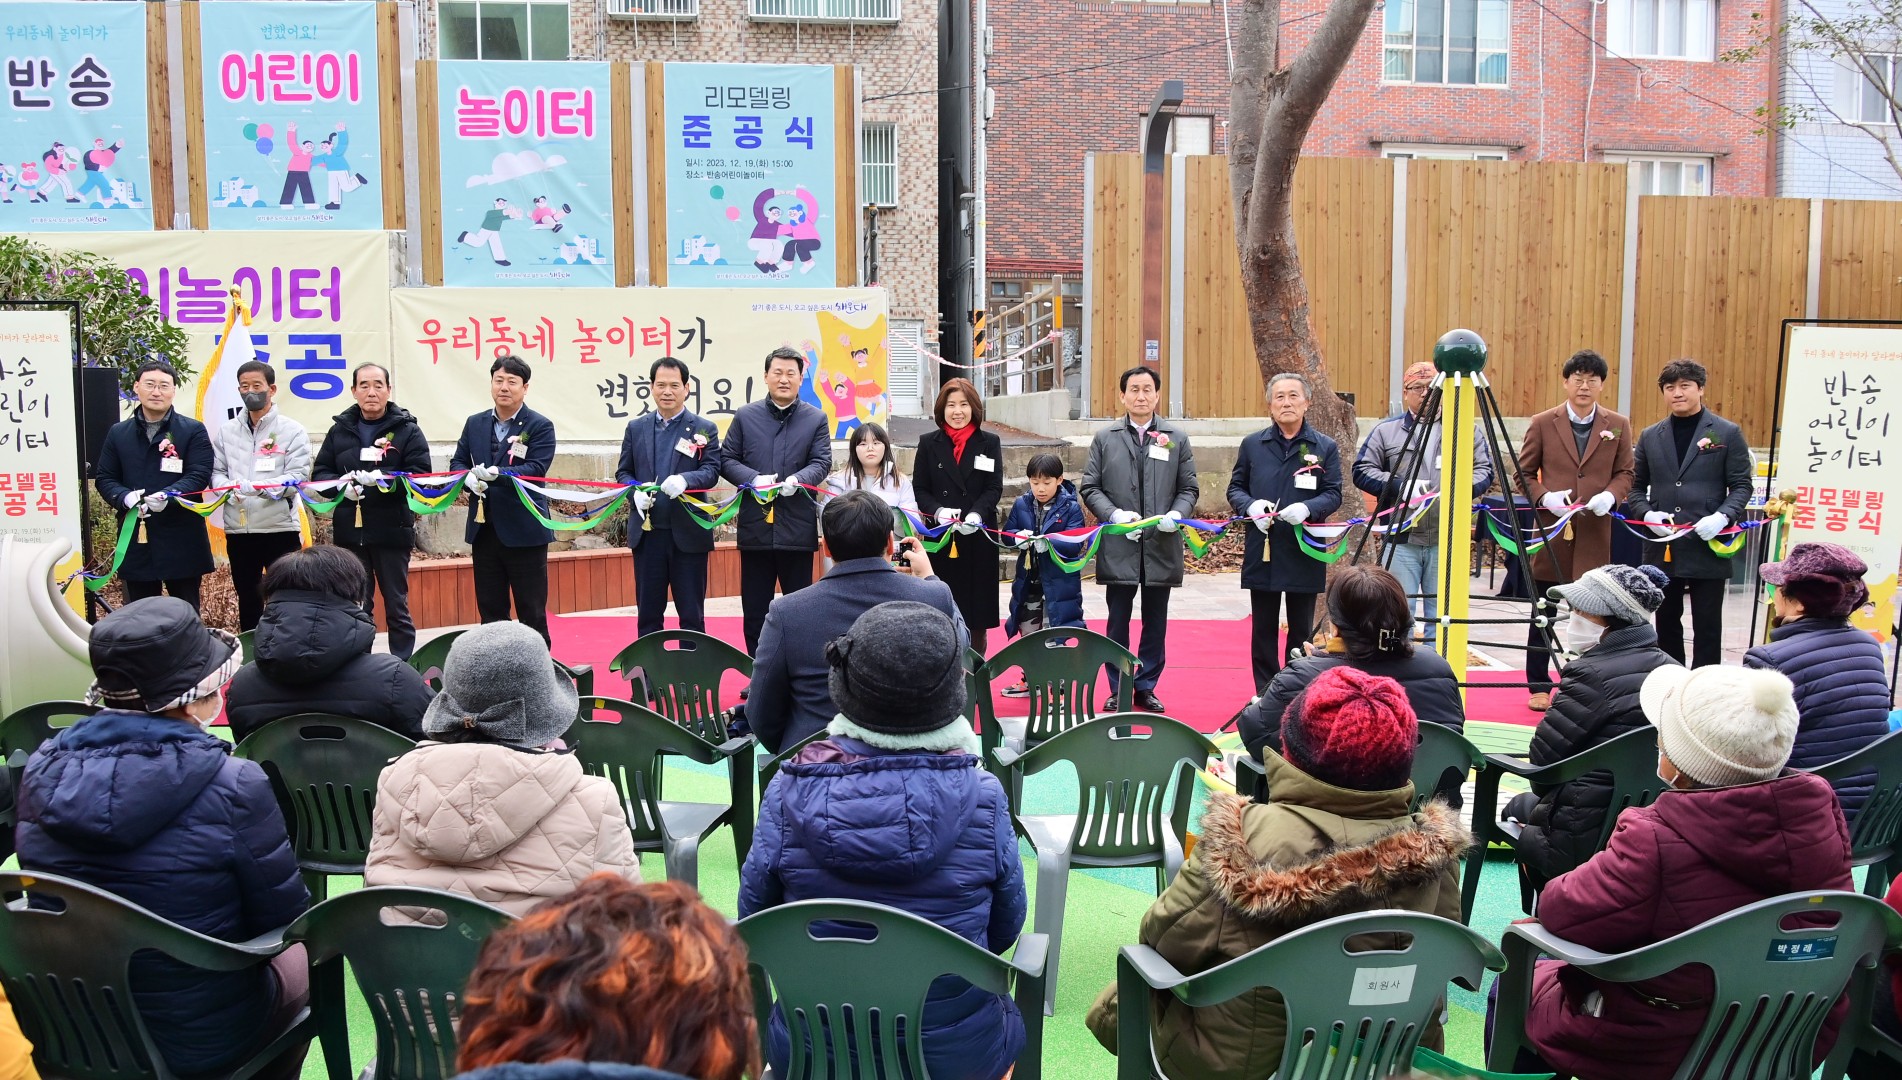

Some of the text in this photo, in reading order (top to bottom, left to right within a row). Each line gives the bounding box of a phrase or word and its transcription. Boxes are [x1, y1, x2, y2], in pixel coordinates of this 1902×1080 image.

[5, 25, 109, 41] 우리동네 놀이터가
[260, 24, 317, 40] 변했어요!
[8, 57, 112, 107] 반송
[222, 53, 359, 102] 어린이
[457, 88, 593, 137] 놀이터
[705, 86, 790, 109] 리모델링
[685, 158, 704, 168] 일시:
[706, 159, 727, 168] 2023.
[730, 159, 741, 167] 12.
[772, 159, 794, 168] 15:00
[685, 170, 765, 180] 장소: 반송어린이놀이터
[752, 304, 764, 312] 살기
[765, 304, 777, 312] 좋은
[807, 304, 819, 312] 싶은
[416, 316, 713, 364] 우리동네 놀이터가
[1824, 370, 1882, 405] 반송
[1808, 406, 1890, 440] 어린이
[1807, 435, 1882, 473] 놀이터
[1796, 486, 1884, 511] 리모델링
[1793, 505, 1882, 536] 준공식
